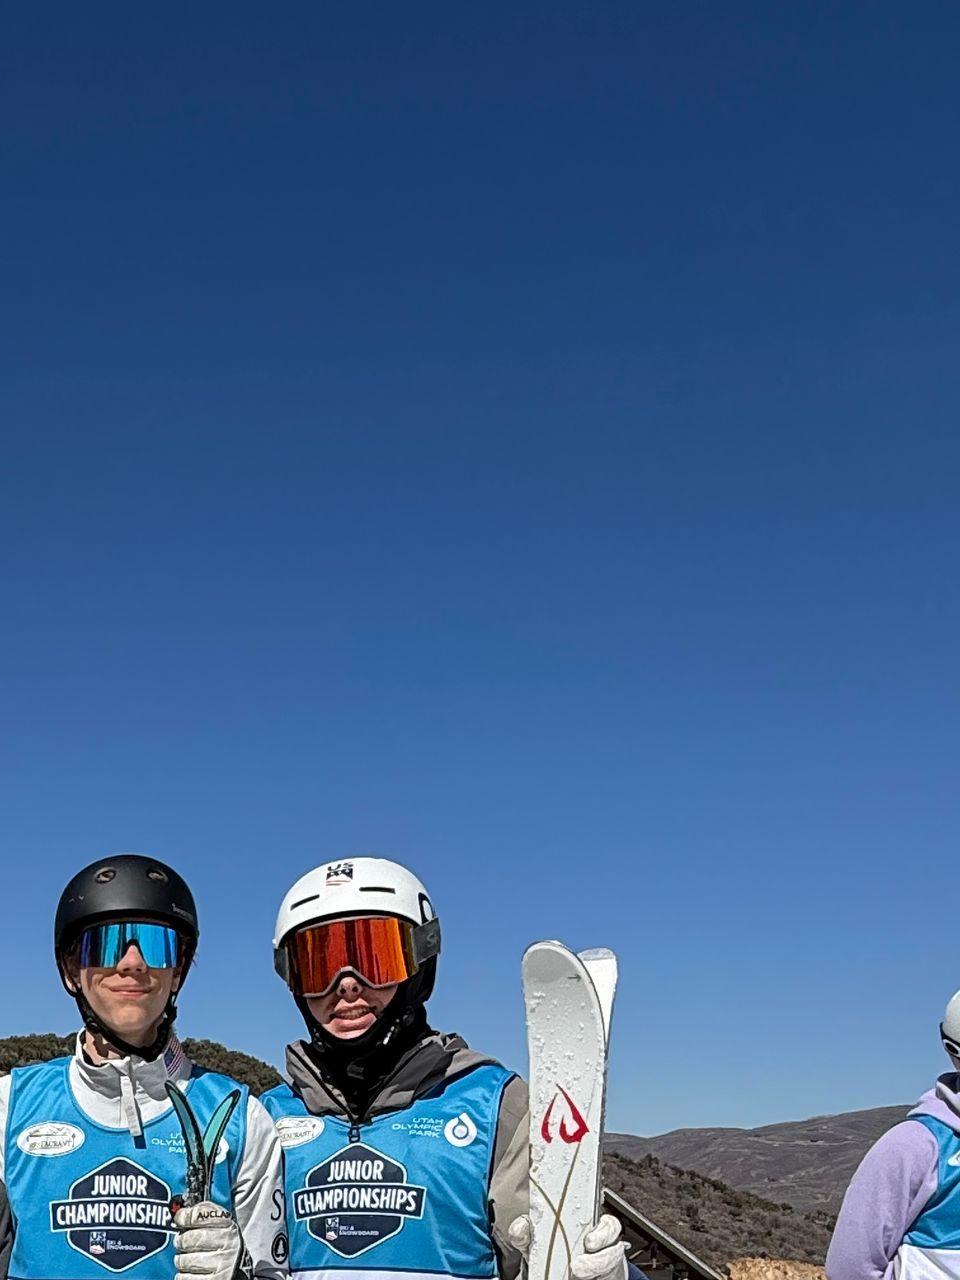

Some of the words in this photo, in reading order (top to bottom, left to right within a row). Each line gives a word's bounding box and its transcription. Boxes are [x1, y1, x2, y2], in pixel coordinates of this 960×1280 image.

[391, 1123, 443, 1132] OLYMPIC
[412, 1117, 444, 1125] UTAH
[408, 1129, 441, 1138] PARK
[326, 1159, 384, 1182] JUNIOR
[91, 1175, 148, 1196] JUNIOR
[296, 1187, 418, 1216] CHAMPIONSHIPS
[56, 1202, 178, 1227] CHAMPIONSHIP
